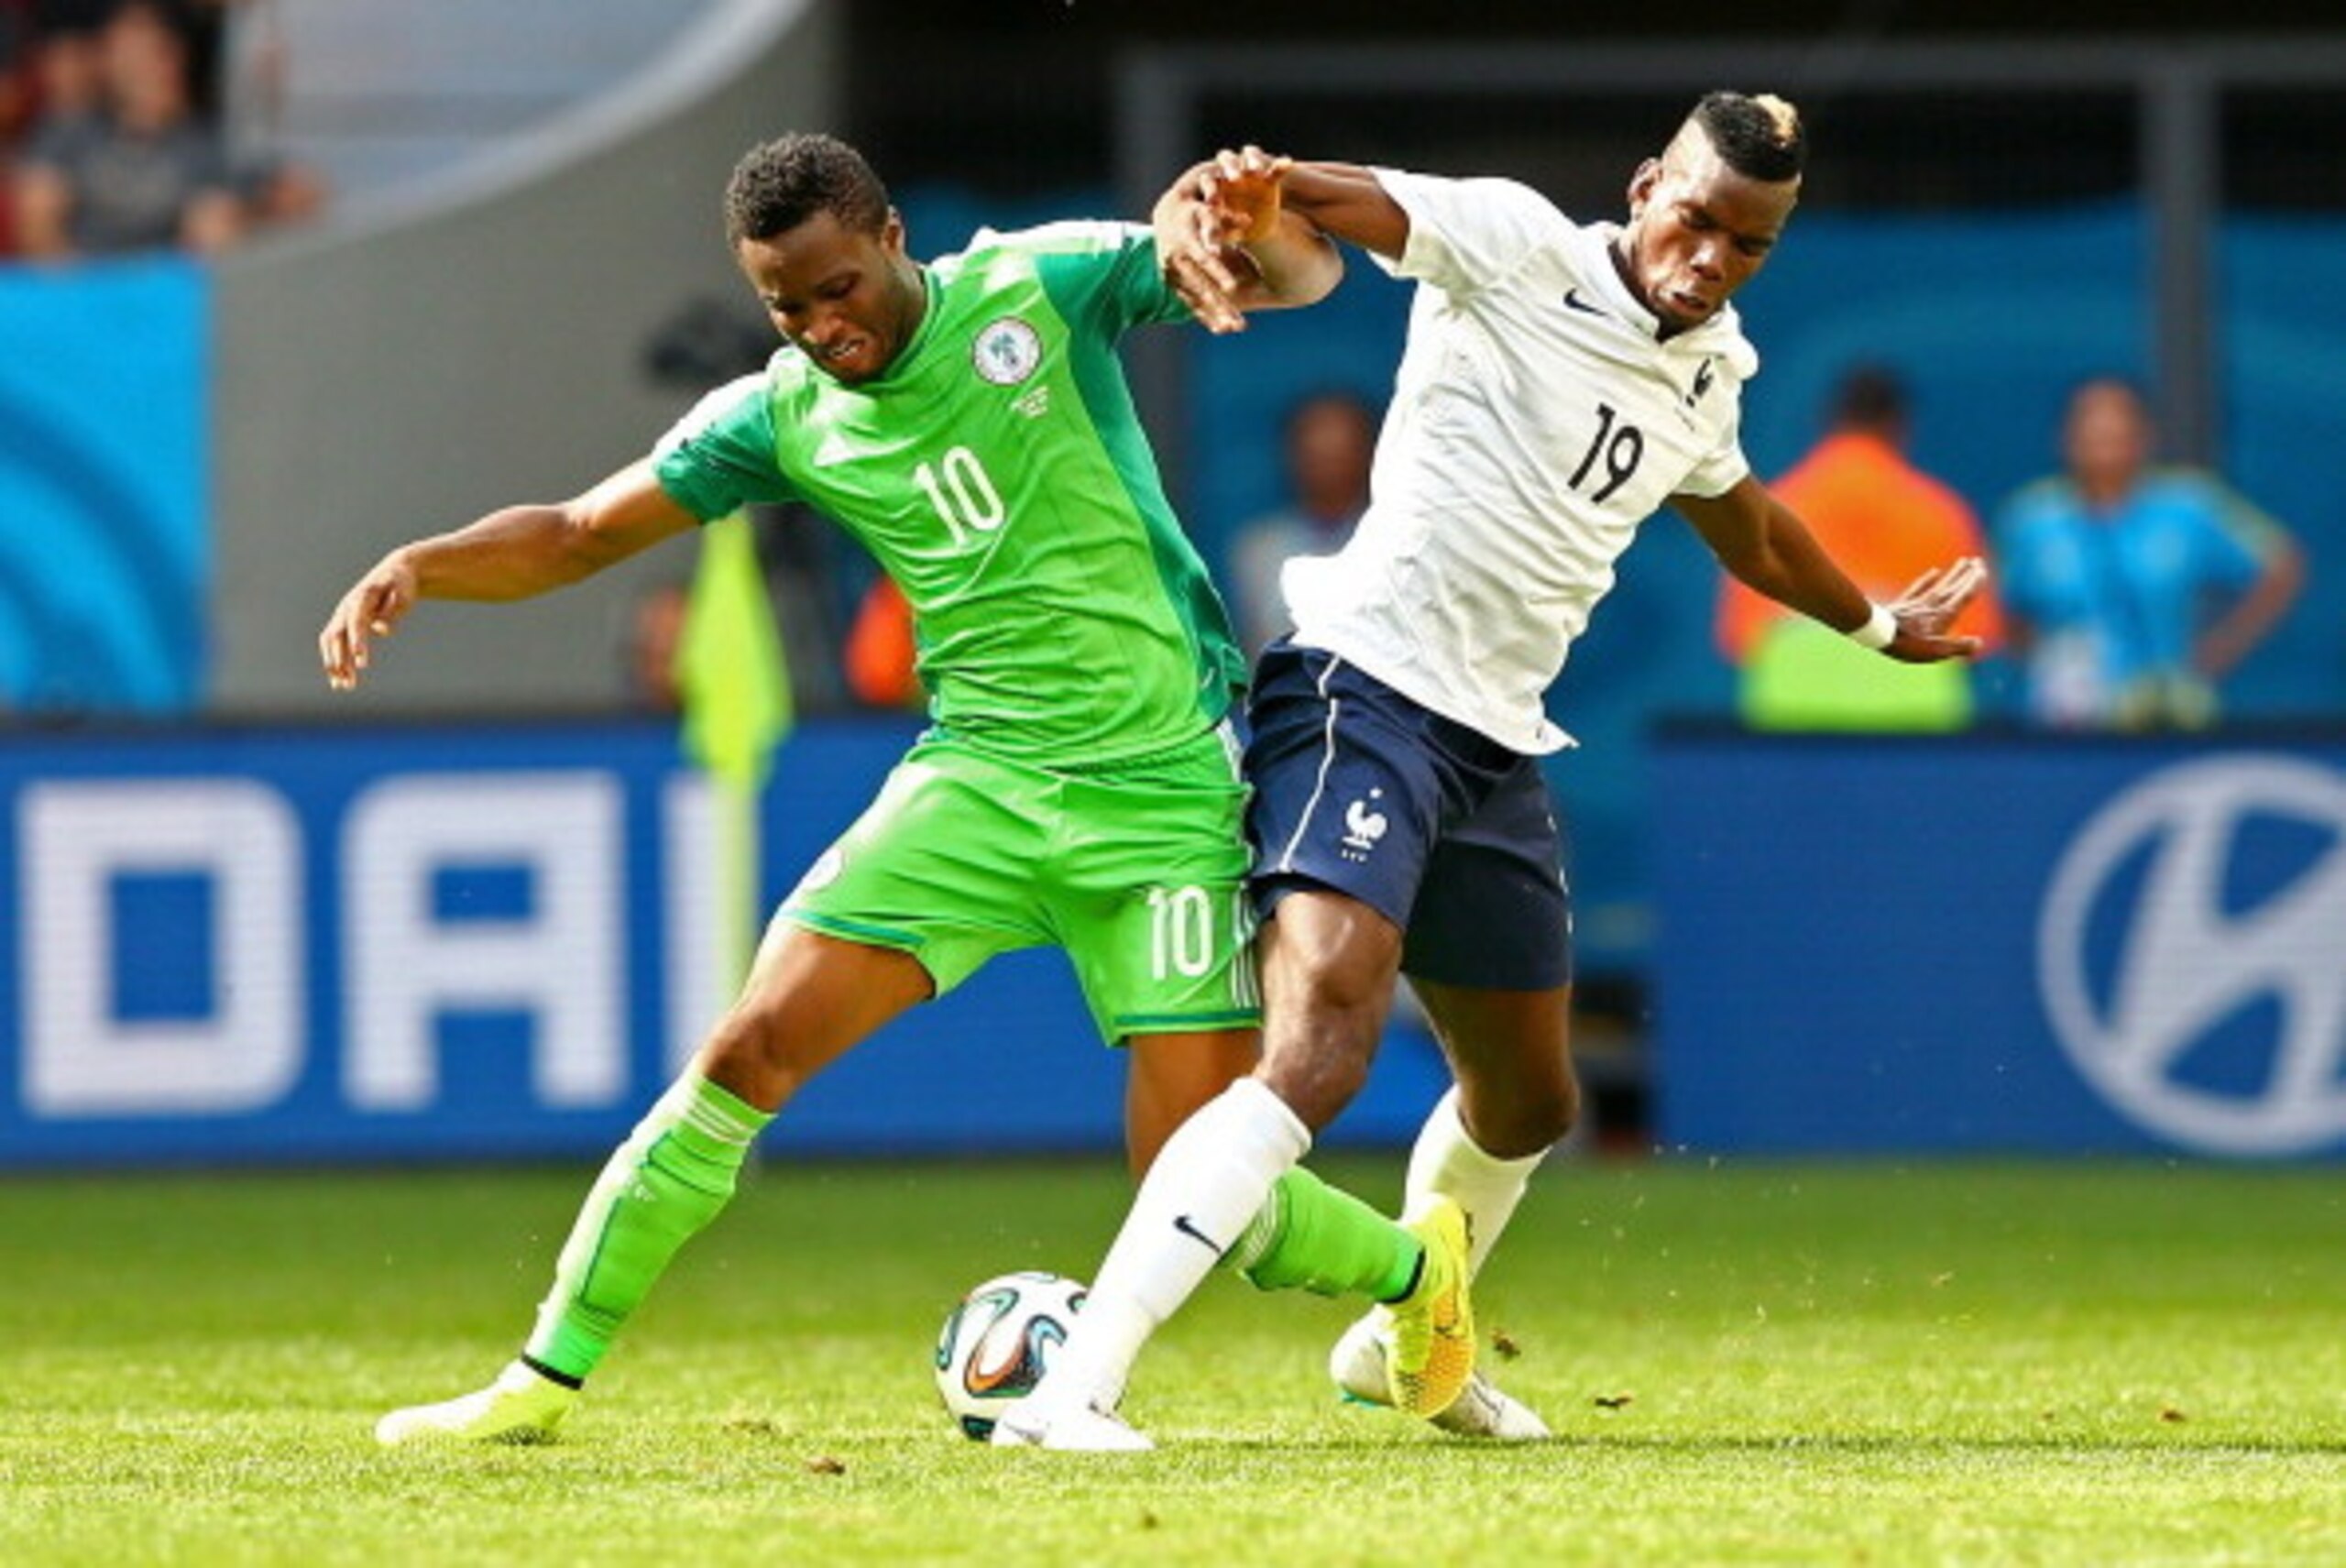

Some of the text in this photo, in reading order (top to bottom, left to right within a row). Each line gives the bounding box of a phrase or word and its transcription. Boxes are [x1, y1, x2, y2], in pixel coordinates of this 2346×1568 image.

[915, 445, 1004, 548] 10
[1567, 400, 1643, 505] 19
[1146, 884, 1213, 981] 10
